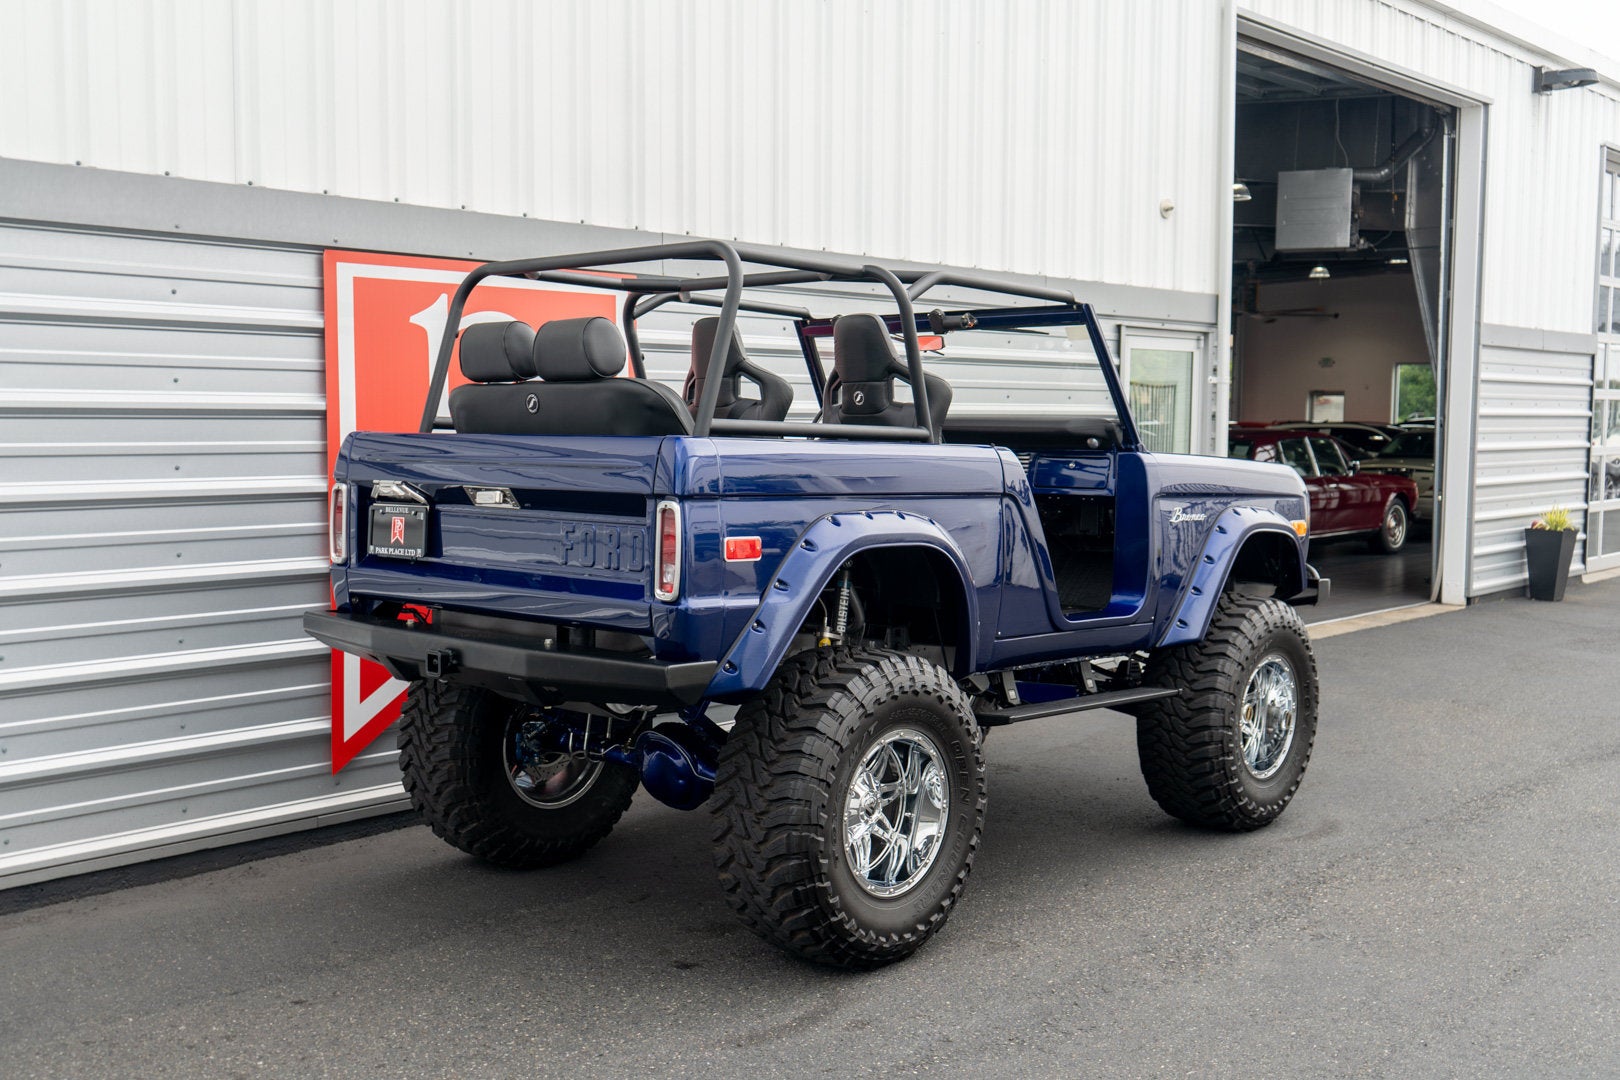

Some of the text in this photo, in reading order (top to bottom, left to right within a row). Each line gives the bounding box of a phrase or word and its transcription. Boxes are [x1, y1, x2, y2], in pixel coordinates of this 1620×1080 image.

[1169, 506, 1207, 523] Bronco
[375, 546, 389, 554] PARK
[389, 547, 405, 556] PLACE
[405, 548, 416, 556] LTD
[560, 520, 645, 572] FORD
[836, 588, 850, 633] BILSTEIN
